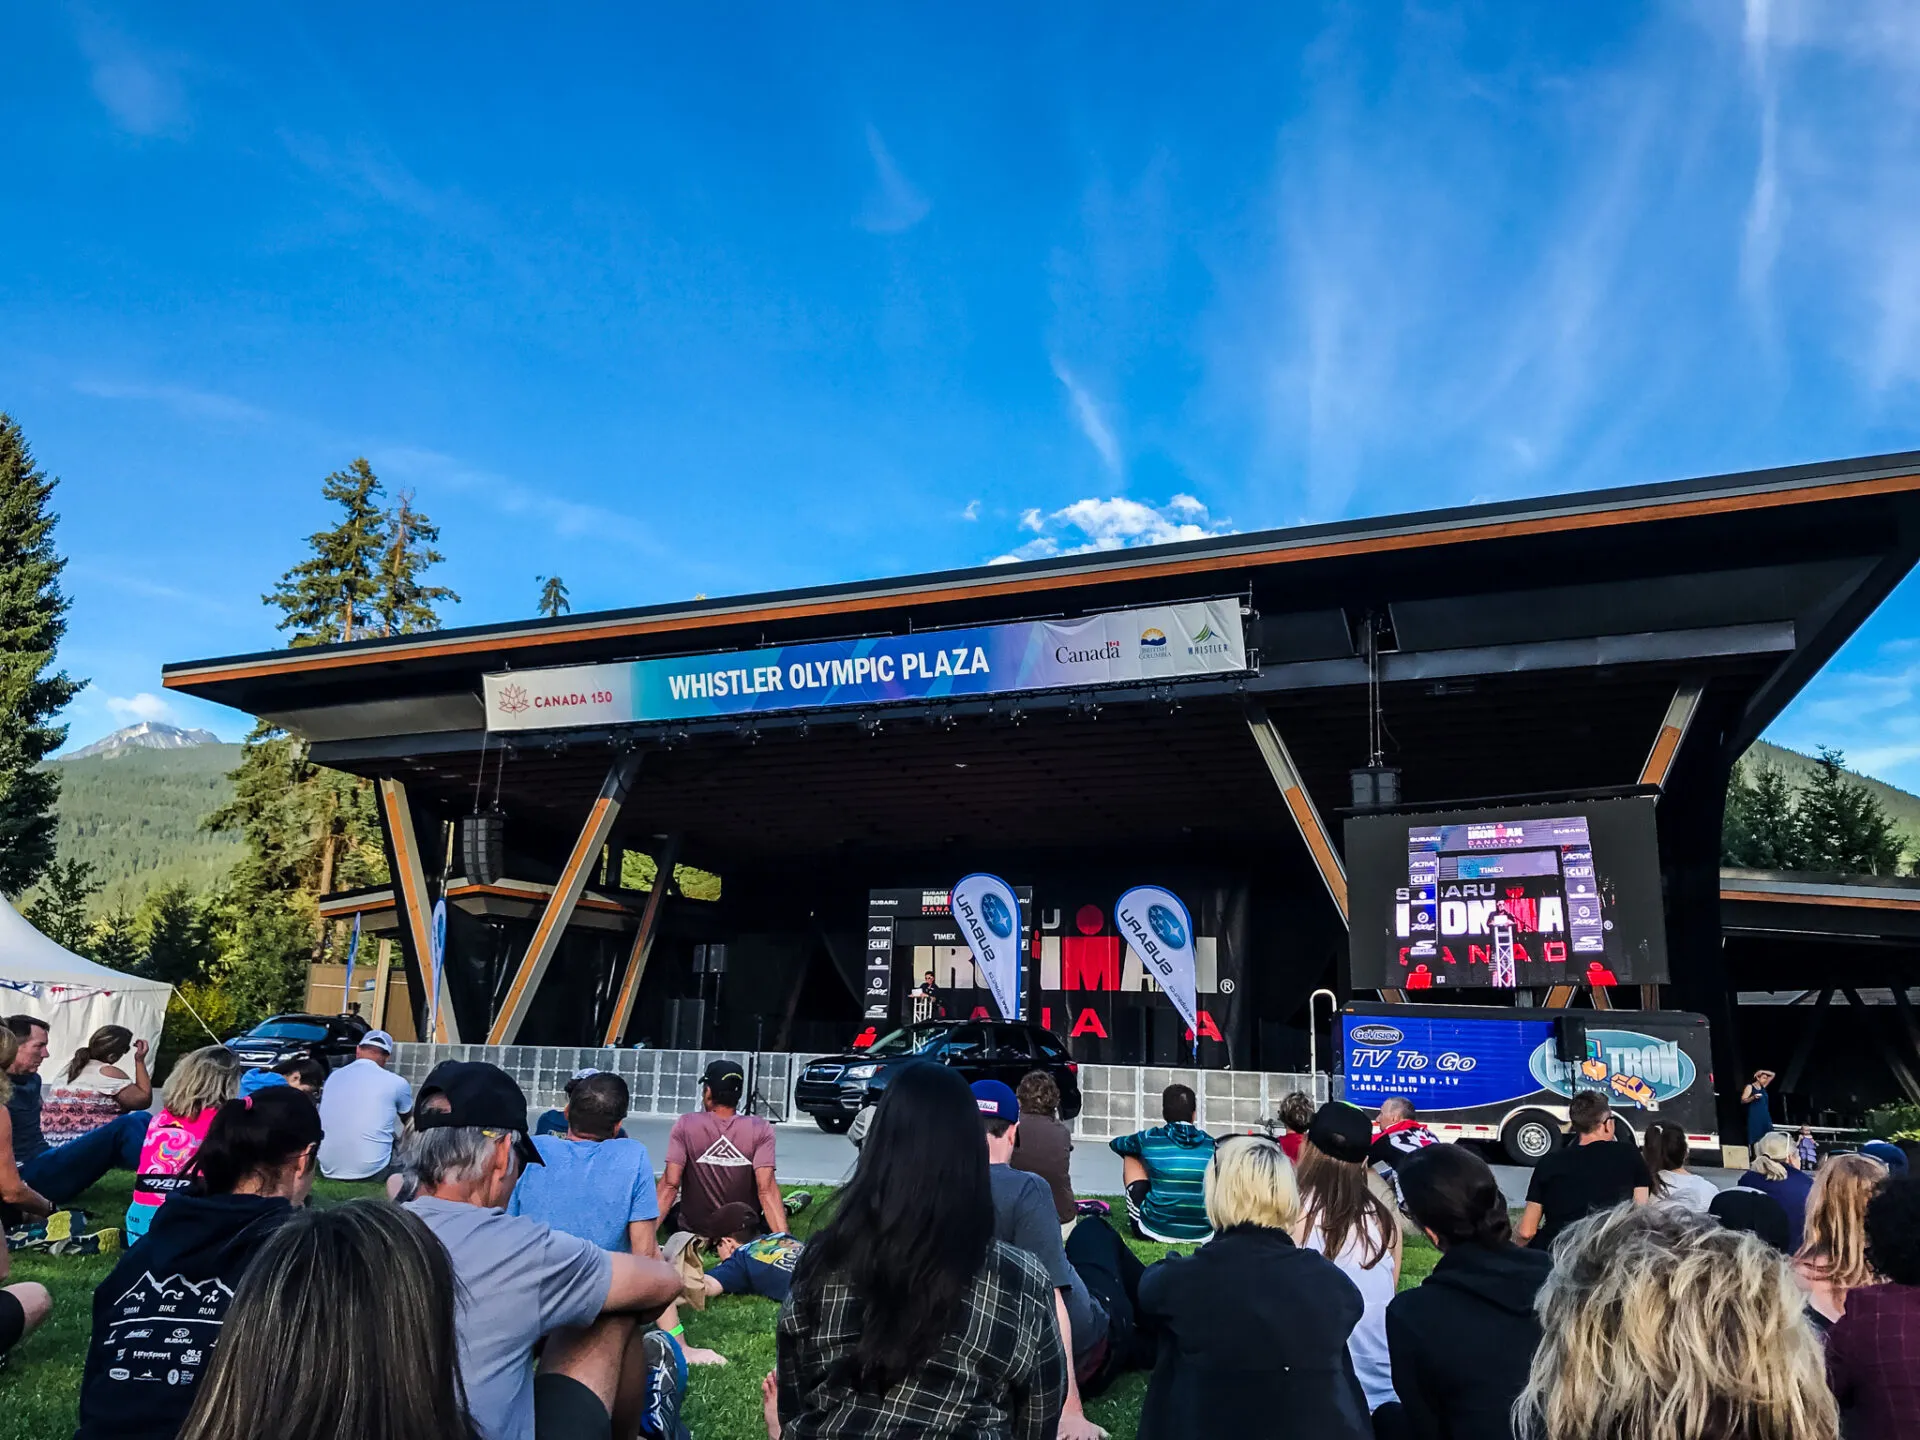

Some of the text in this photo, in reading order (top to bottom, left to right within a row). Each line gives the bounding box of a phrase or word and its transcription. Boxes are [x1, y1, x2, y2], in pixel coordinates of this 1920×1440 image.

[1055, 641, 1121, 664] Canada
[1188, 643, 1228, 655] WHISTLER
[668, 646, 990, 700] WHISTLER OLYMPIC PLAZA
[534, 691, 613, 708] CANADA 150
[1467, 827, 1524, 839] IRONMAN
[1563, 852, 1592, 860] ACTIVE
[1569, 868, 1590, 876] CLIF
[1412, 875, 1434, 883] CLIF
[1352, 1049, 1476, 1072] TV To Go
[1351, 1073, 1459, 1086] www.jumbo.tv
[158, 1304, 177, 1313] BIKE
[198, 1307, 216, 1315] RUN
[186, 1349, 202, 1357] 98.5
